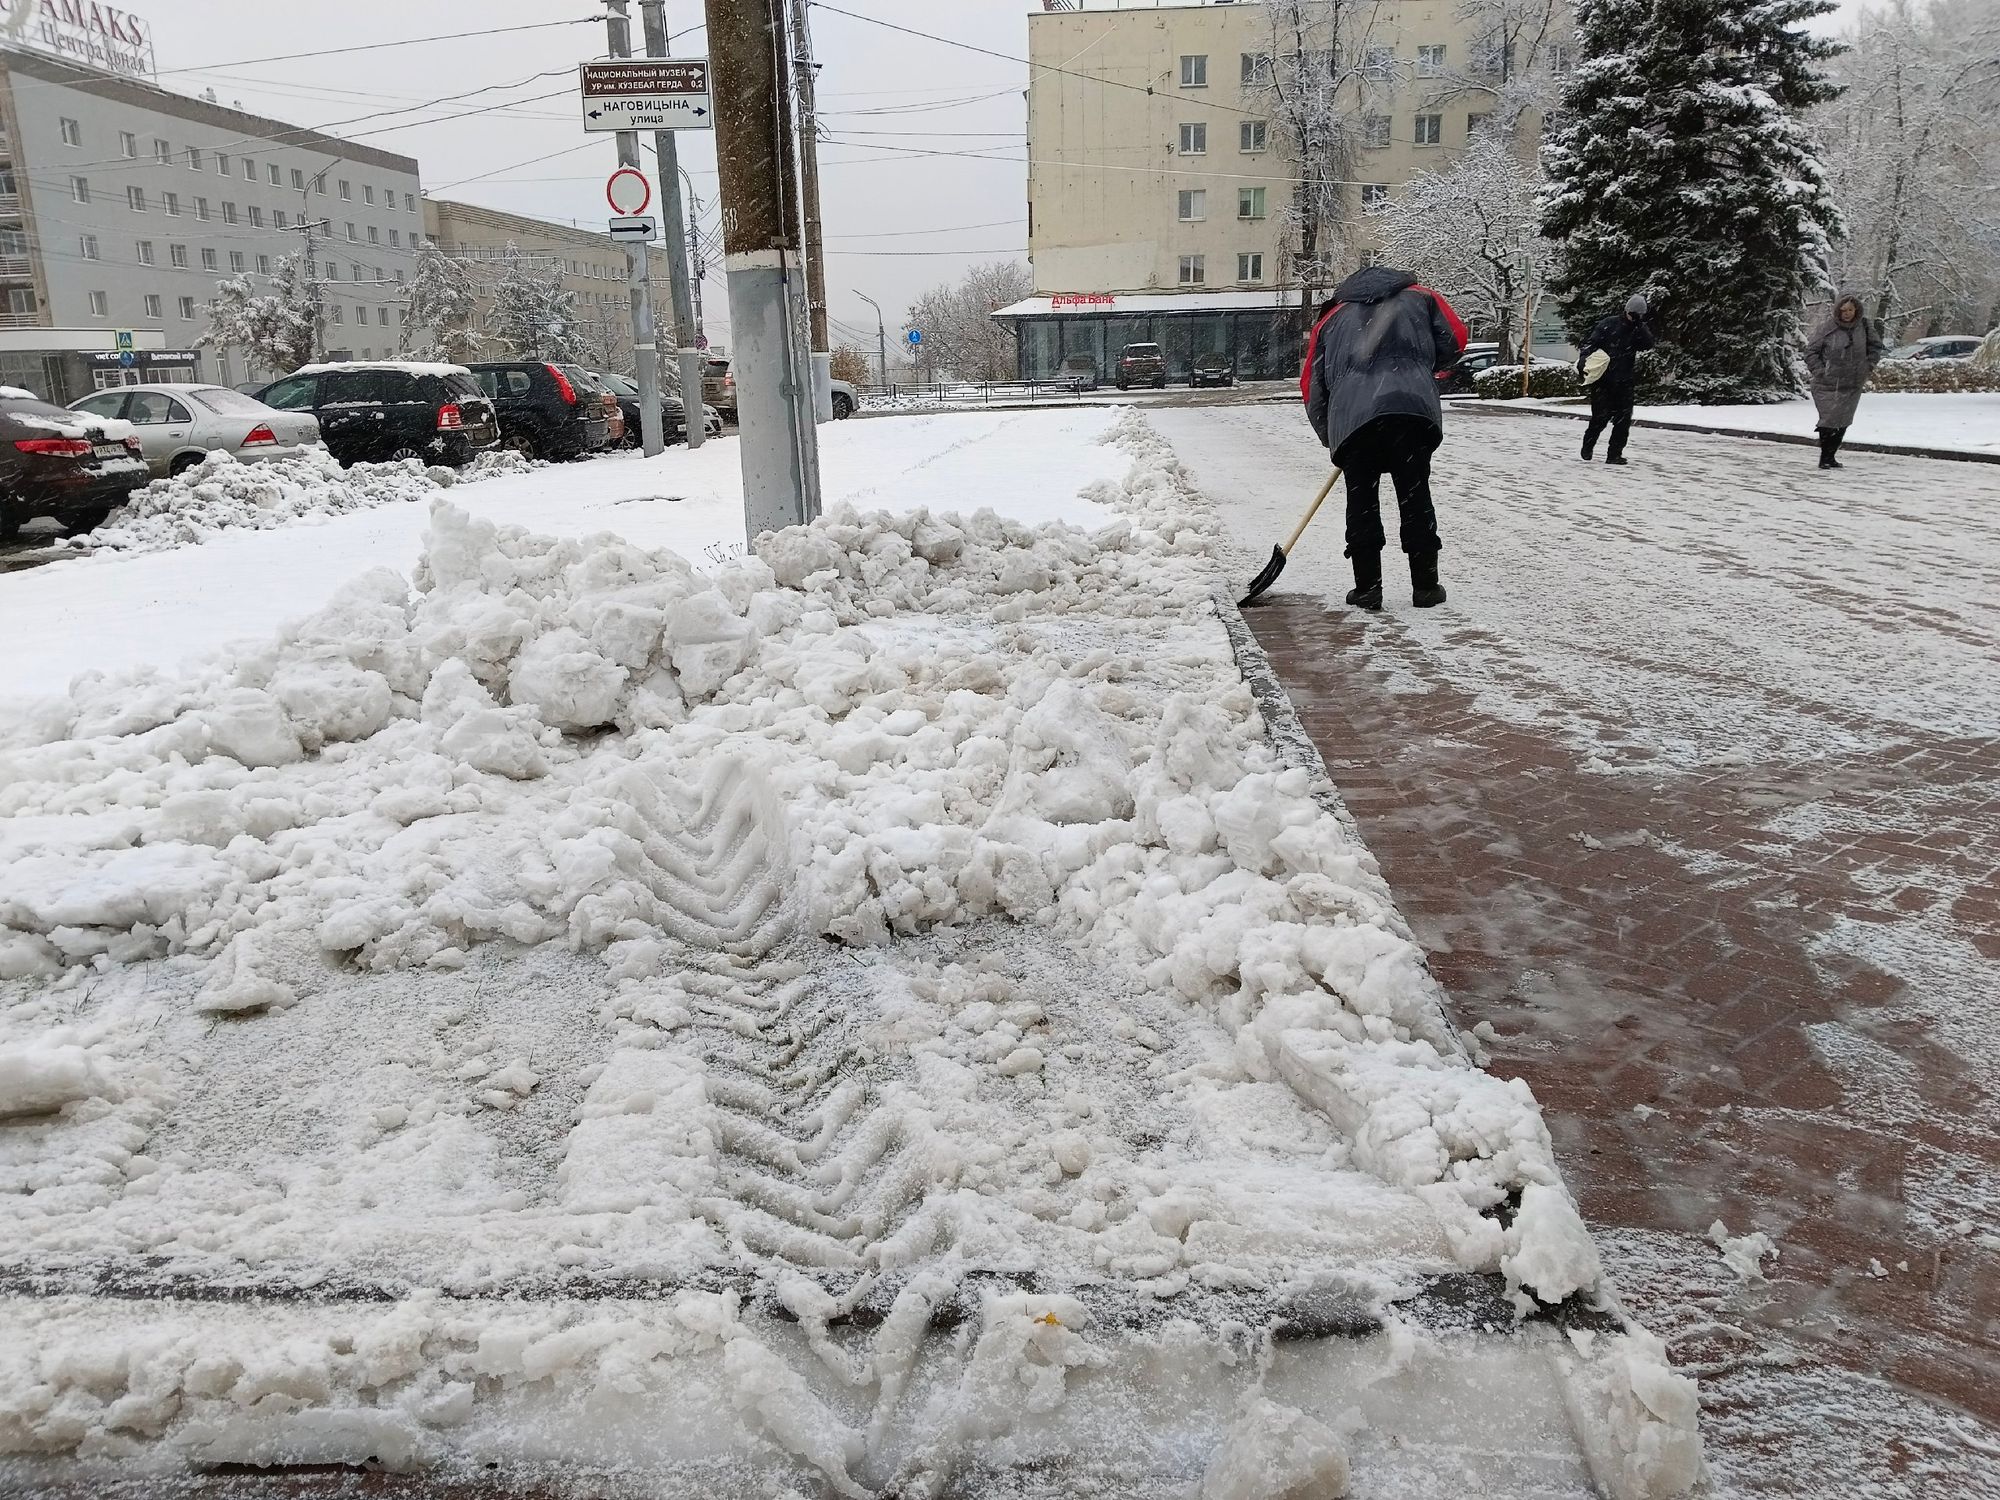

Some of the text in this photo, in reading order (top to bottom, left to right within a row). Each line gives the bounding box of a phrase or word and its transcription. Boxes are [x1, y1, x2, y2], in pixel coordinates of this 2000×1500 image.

[40, 21, 147, 73] Центральная
[587, 68, 687, 80] НАЦИОНАЛЬНЫЙ МУЗЕЙ
[618, 81, 655, 89] КУЗЕБАЯ
[656, 81, 684, 89] ГЕРДА
[690, 80, 704, 89] 0,2
[603, 99, 690, 112] НАГОВИЦЫНА
[630, 115, 664, 126] улица
[1088, 294, 1115, 304] Банк
